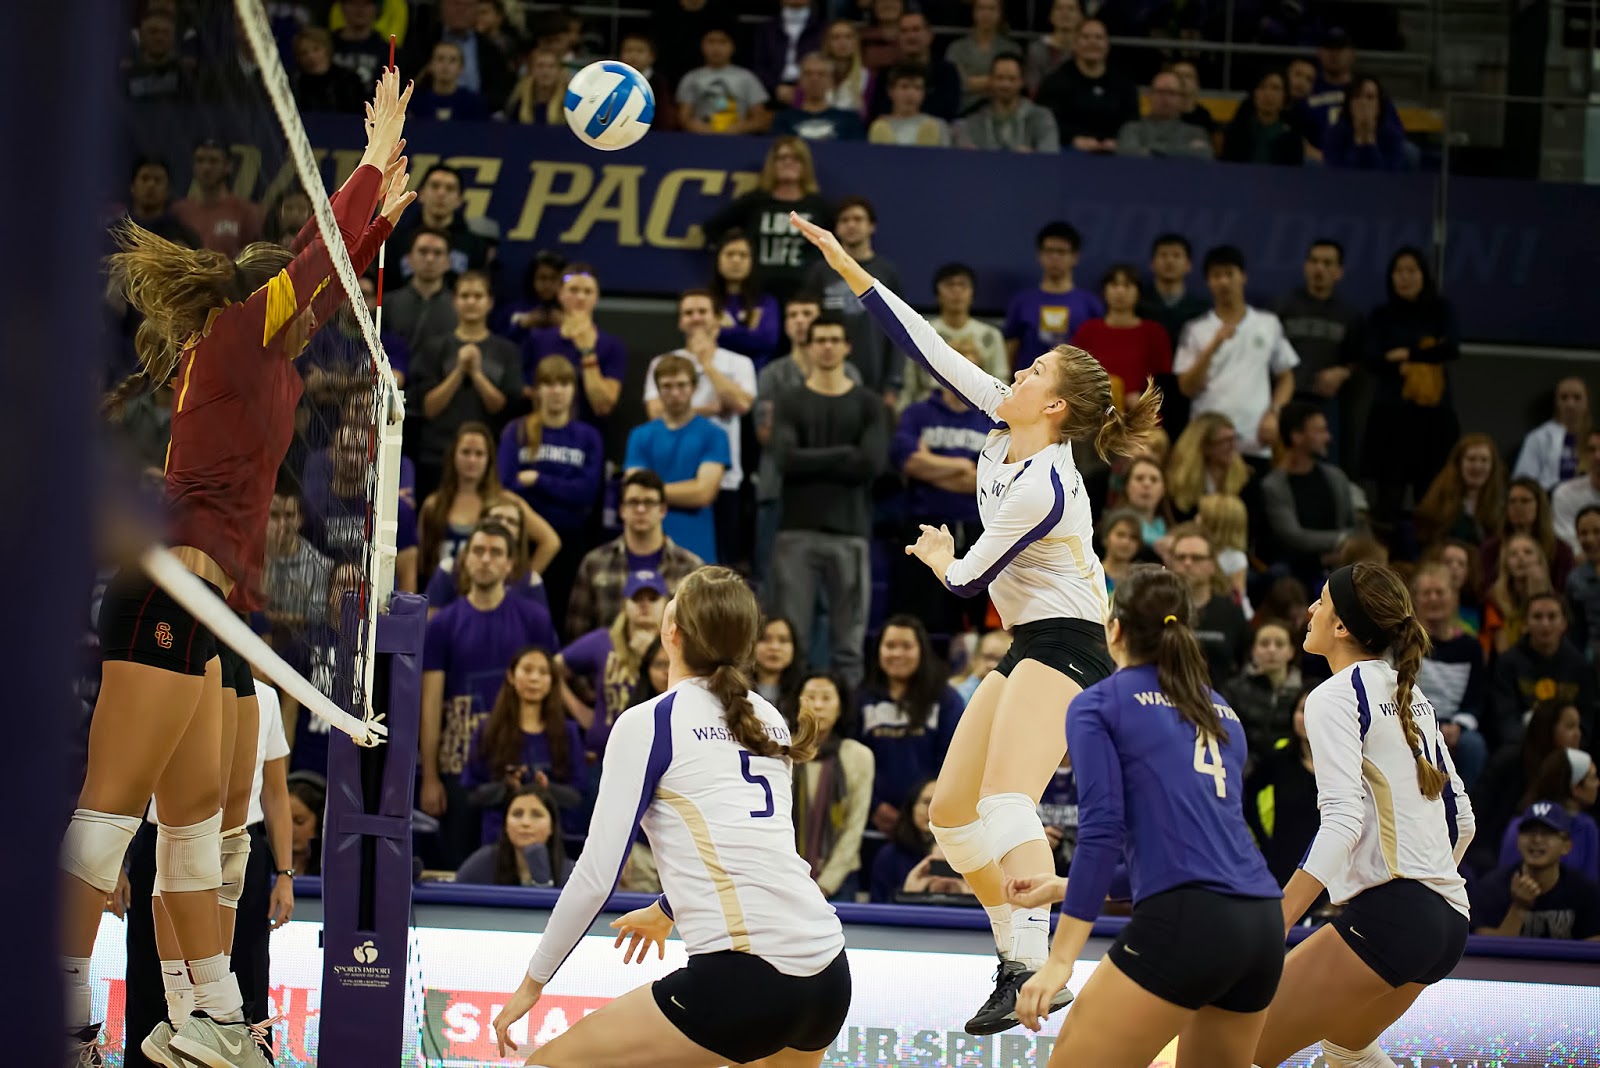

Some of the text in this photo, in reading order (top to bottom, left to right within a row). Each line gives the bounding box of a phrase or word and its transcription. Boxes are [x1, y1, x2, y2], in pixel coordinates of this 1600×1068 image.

[692, 726, 790, 742] WASHTON
[1193, 722, 1227, 799] 4
[738, 749, 775, 819] 5
[1532, 803, 1552, 816] W
[443, 1001, 600, 1046] SHA
